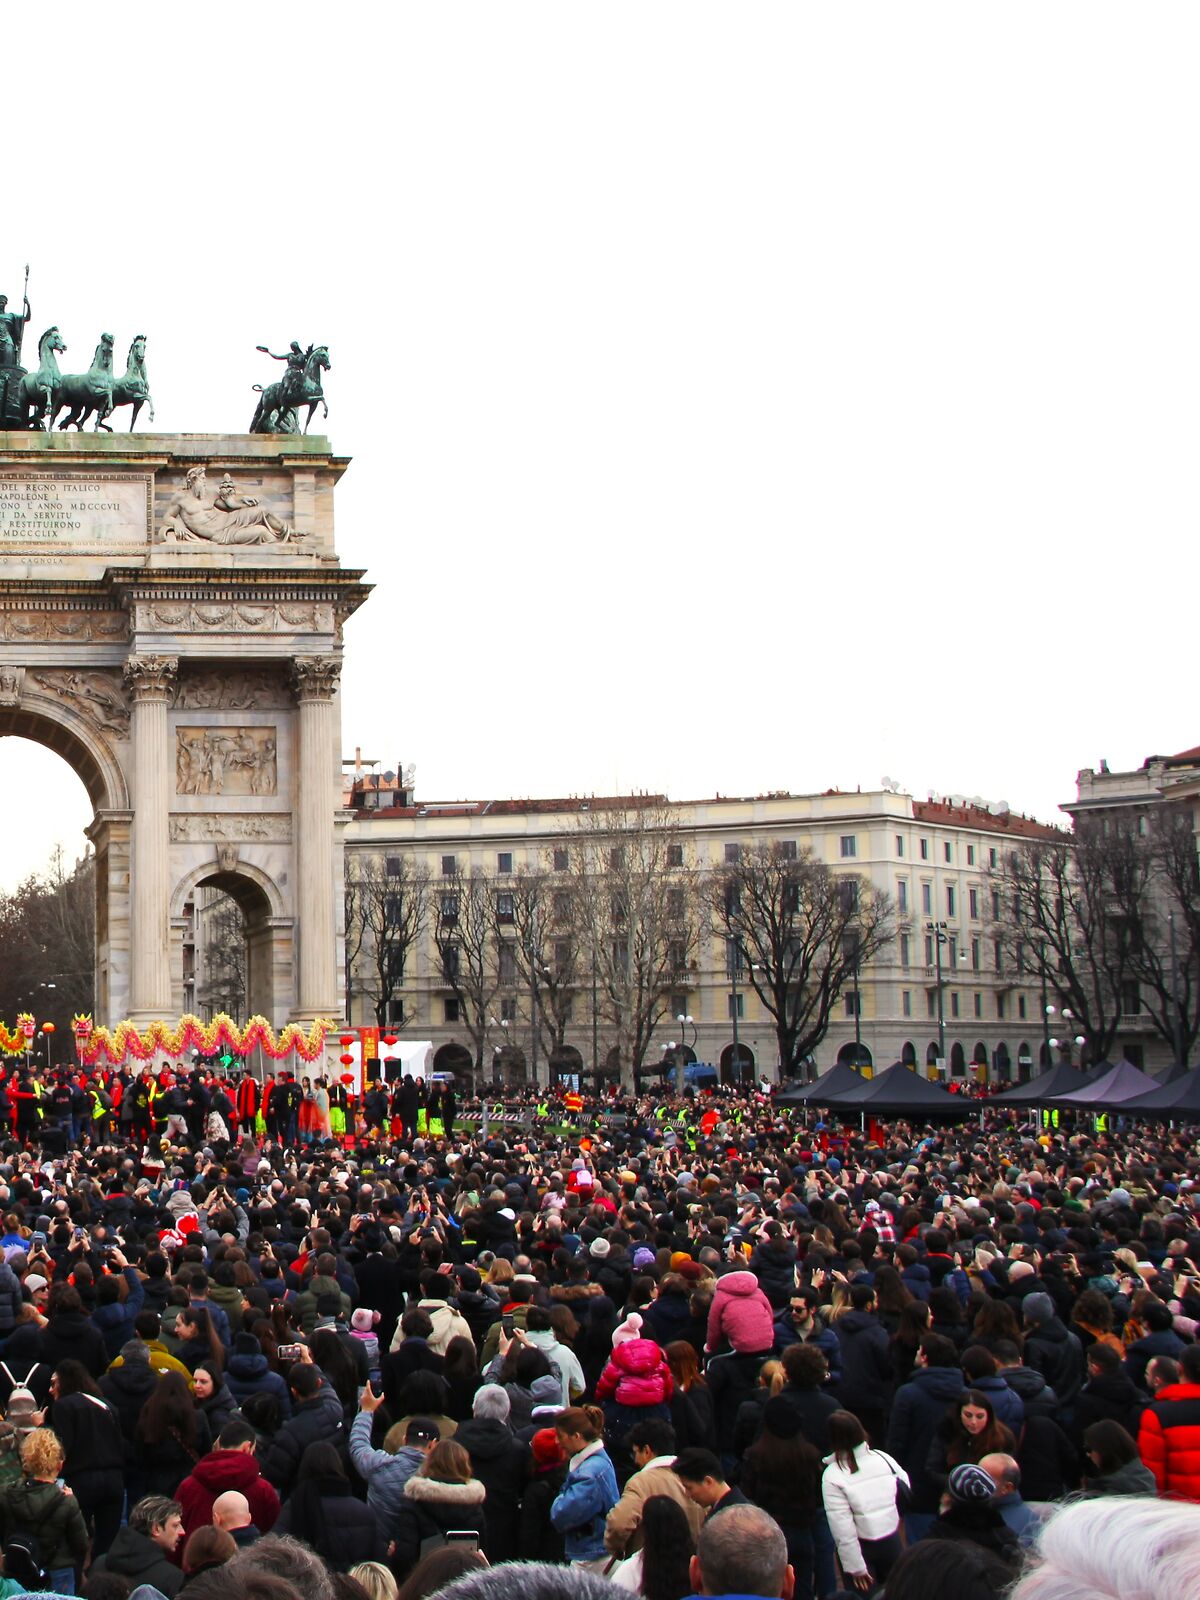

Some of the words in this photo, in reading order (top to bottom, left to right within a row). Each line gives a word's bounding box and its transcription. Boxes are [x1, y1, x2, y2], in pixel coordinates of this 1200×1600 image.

[26, 484, 57, 492] REGNO
[70, 503, 120, 511] MDCCCVII
[9, 521, 81, 529] RESTITUIRONO
[3, 530, 58, 538] MDCCCLIX
